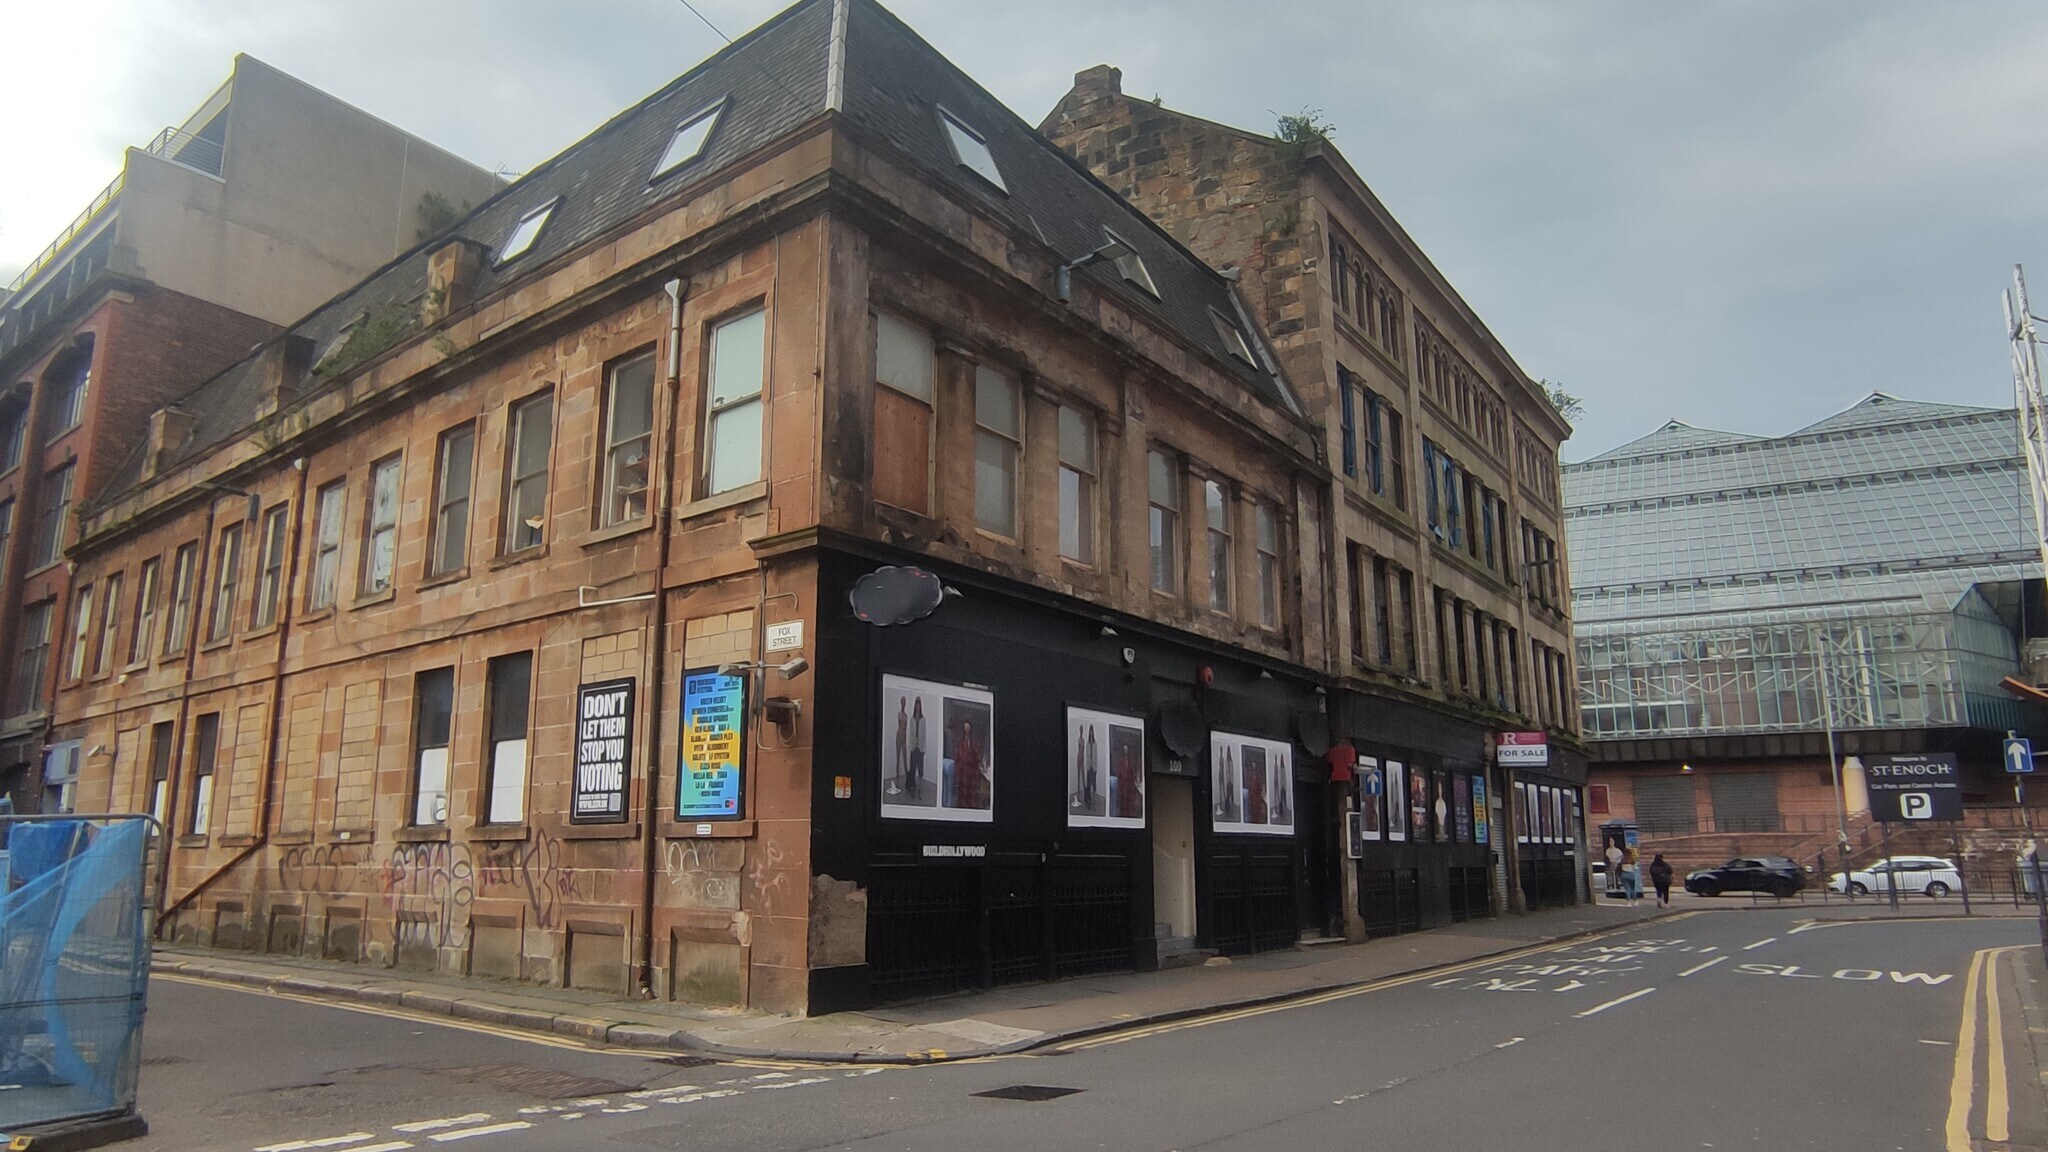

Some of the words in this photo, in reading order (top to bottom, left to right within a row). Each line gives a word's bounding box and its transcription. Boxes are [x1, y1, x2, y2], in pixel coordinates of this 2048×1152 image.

[772, 635, 796, 647] STREET
[778, 626, 791, 636] FOX
[583, 691, 627, 719] DON'T
[582, 719, 599, 740] LET
[599, 716, 626, 738] THEM
[581, 740, 605, 763] STOP
[605, 738, 625, 761] YOU
[1498, 749, 1518, 757] FOR
[1521, 749, 1546, 757] SALE
[580, 761, 623, 792] VOTING
[1732, 963, 1954, 985] SLOW
